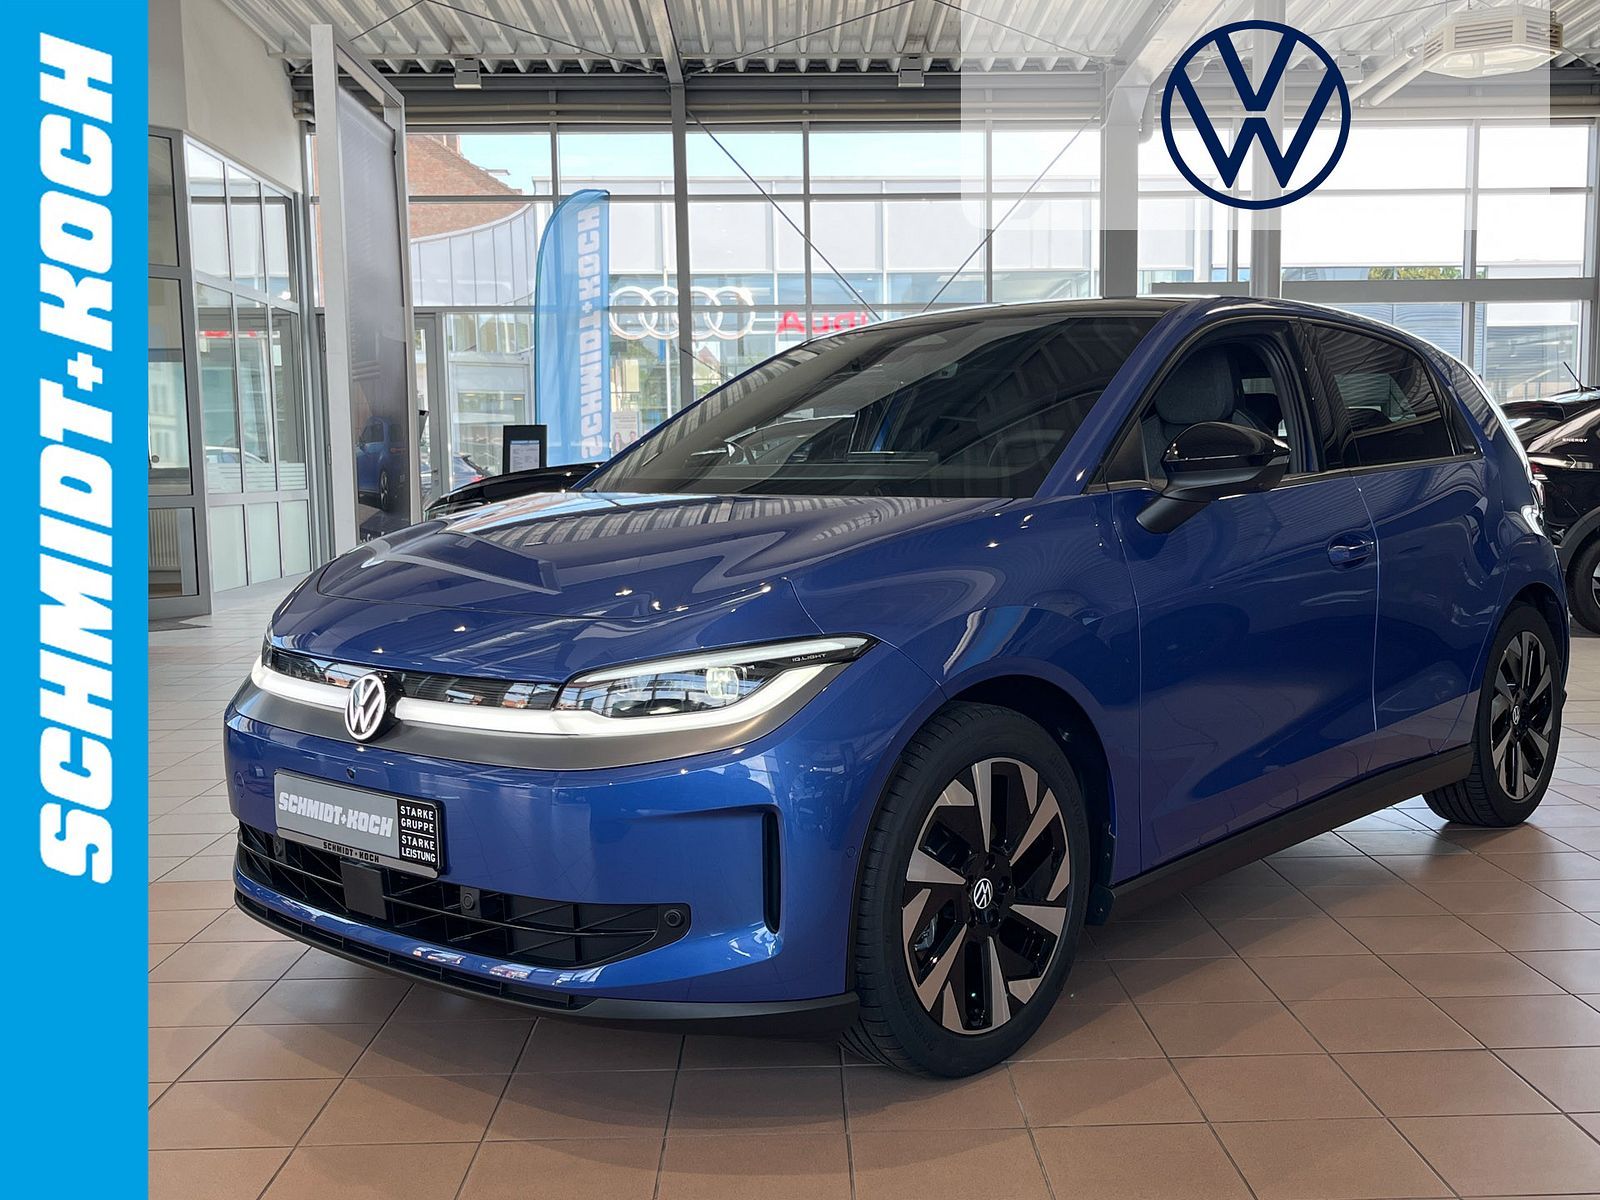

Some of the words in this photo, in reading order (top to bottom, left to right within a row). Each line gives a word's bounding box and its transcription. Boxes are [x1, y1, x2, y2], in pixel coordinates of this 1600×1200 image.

[344, 674, 386, 740] VW
[278, 791, 393, 838] SCHMIDT+KOCH
[400, 805, 434, 821] STARKE
[401, 817, 434, 833] GRUPPE
[401, 834, 435, 851] STARKE
[359, 851, 380, 864] KOCH
[401, 847, 436, 863] LEISTUNG
